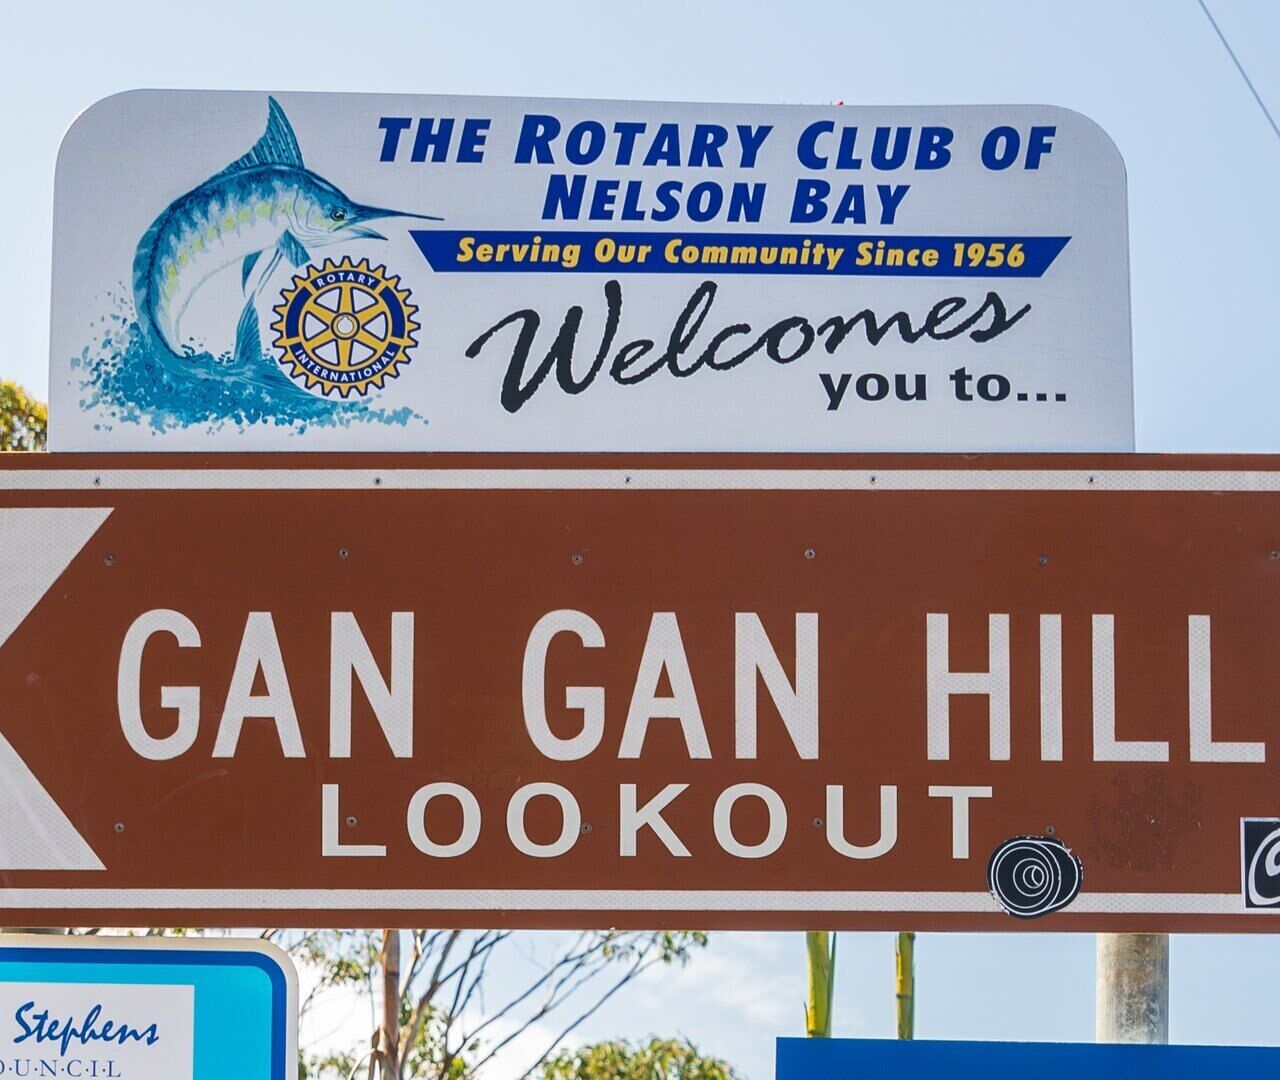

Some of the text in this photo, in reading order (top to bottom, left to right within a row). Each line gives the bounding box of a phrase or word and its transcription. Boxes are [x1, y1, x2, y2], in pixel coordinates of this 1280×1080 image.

[379, 115, 1056, 170] THE ROTARY CLUB OF
[542, 174, 910, 224] NELSON BAY
[457, 236, 1024, 269] Serving Our Community Since 1956
[317, 273, 375, 286] ROTARY
[295, 350, 395, 382] INTERNATIONAL
[465, 280, 1031, 412] Welcomes
[819, 367, 1066, 410] you to...
[118, 609, 414, 760] GAN
[522, 609, 818, 761] GAN
[927, 613, 1265, 762] HILL
[322, 782, 993, 859] LOOKOUT
[14, 1002, 159, 1056] Stephens
